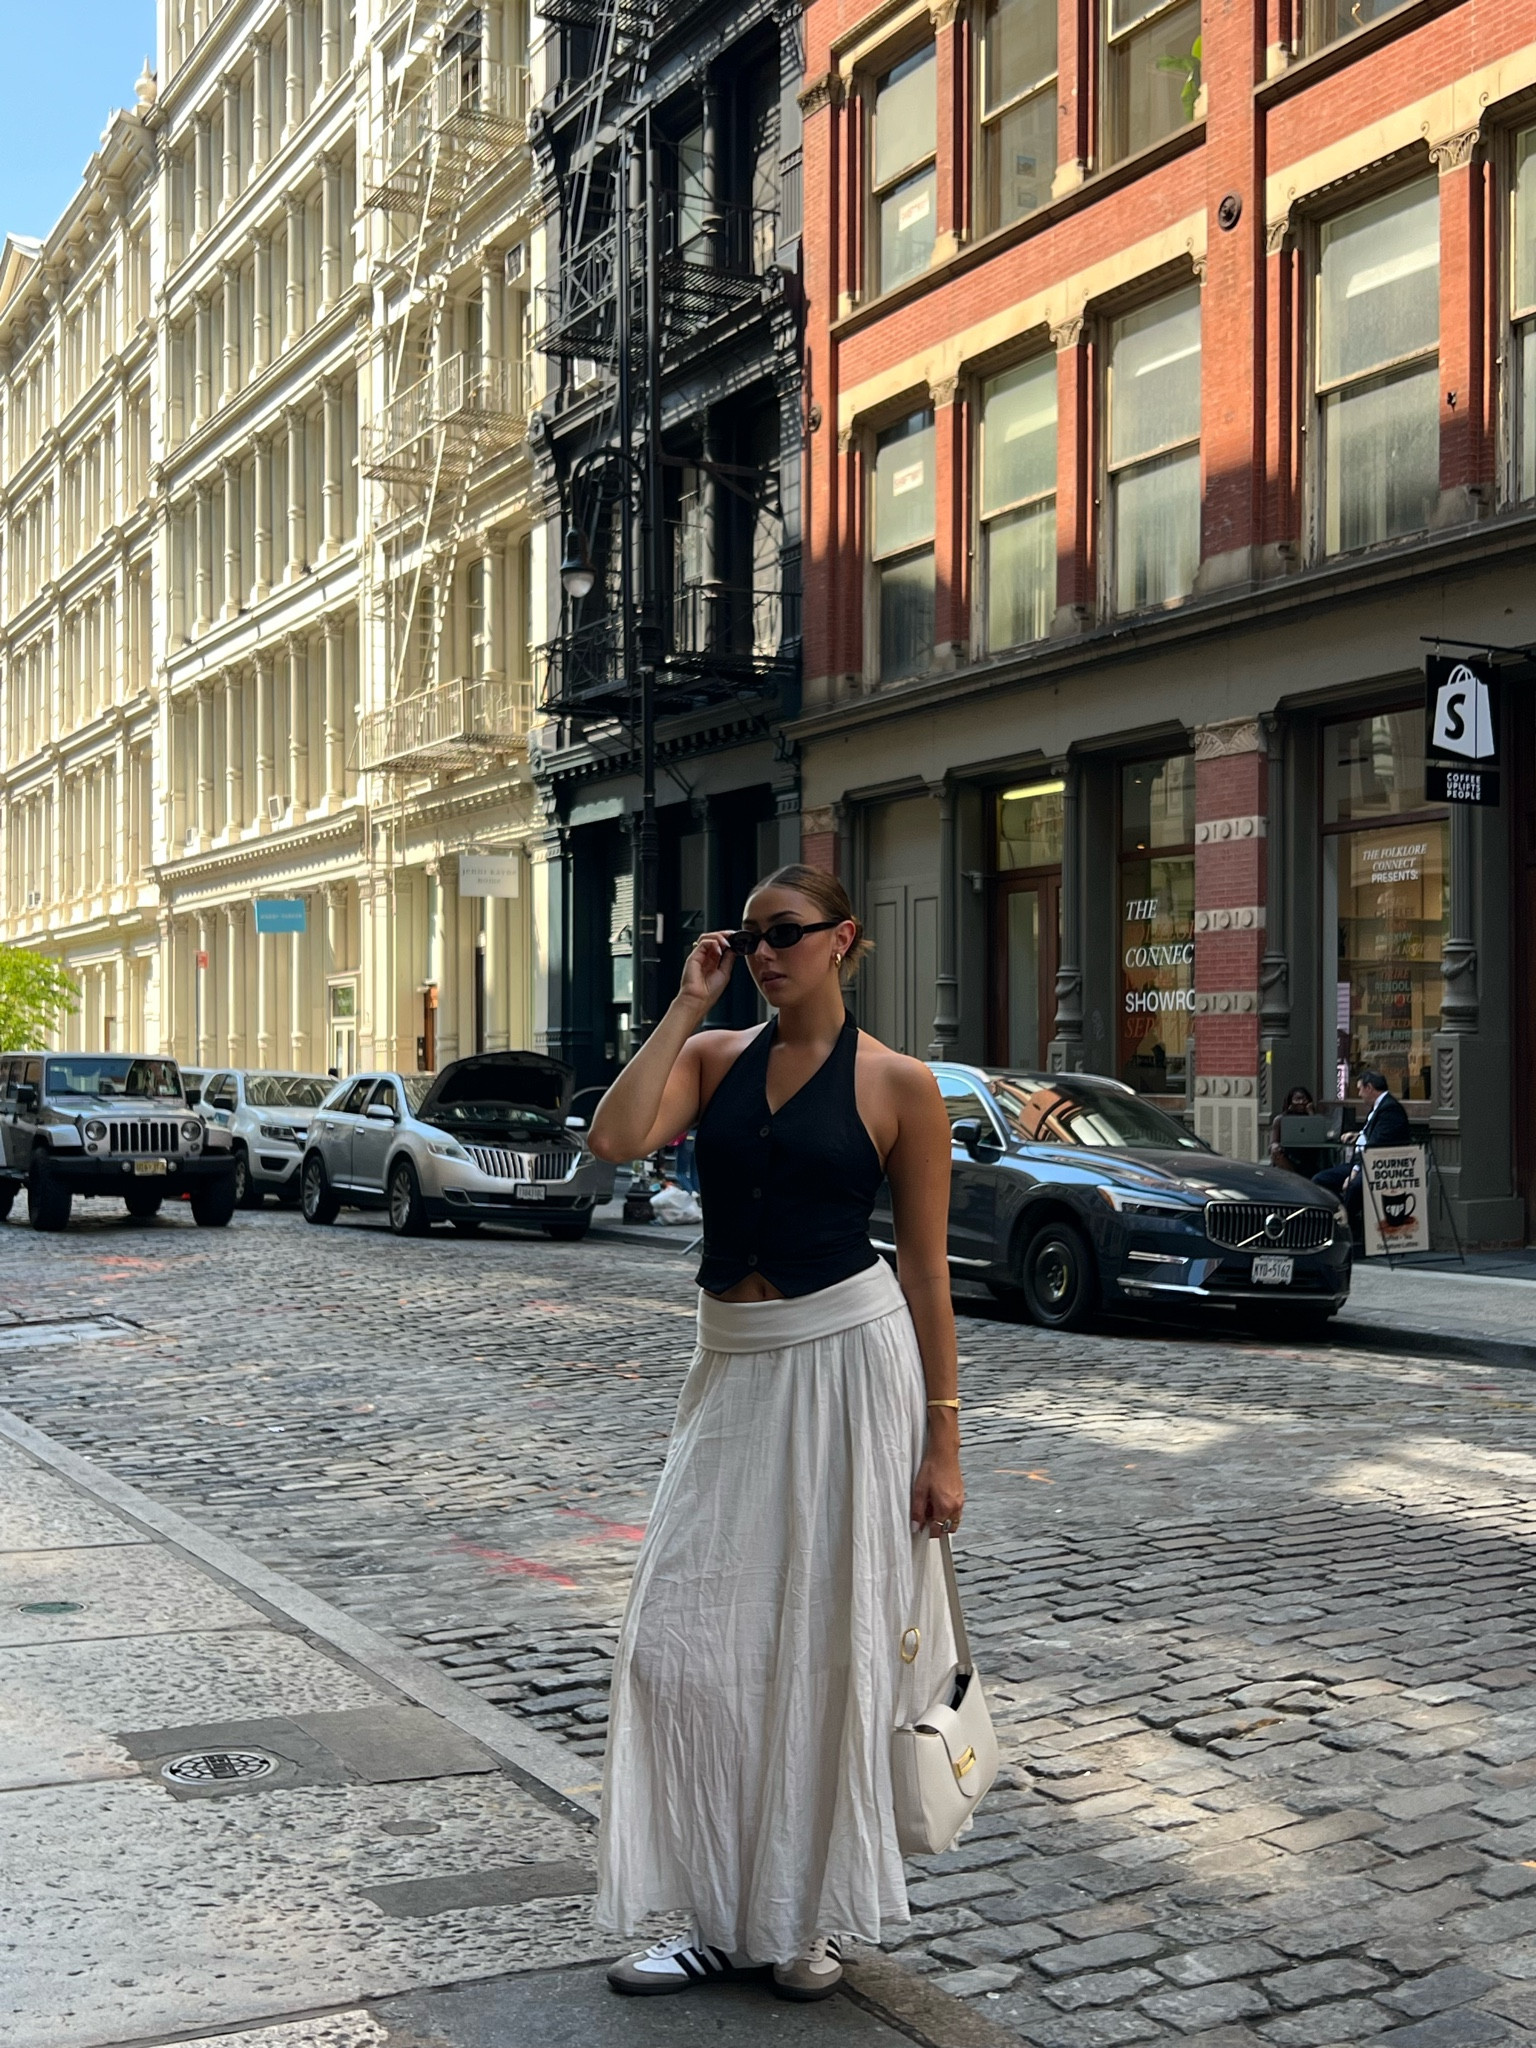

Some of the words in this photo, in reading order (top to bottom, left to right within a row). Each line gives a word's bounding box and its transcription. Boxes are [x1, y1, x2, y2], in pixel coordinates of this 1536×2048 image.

[1444, 693, 1466, 741] S
[1446, 772, 1481, 784] COFFEE
[1446, 782, 1481, 792] UPLIFTS
[1446, 790, 1481, 801] PEOPLE
[1363, 850, 1379, 861] THE
[1380, 843, 1428, 859] FOLKLORE
[1372, 858, 1417, 872] CONNECT
[1371, 869, 1419, 884] PRESENTS:
[1125, 899, 1158, 921] THE
[1125, 943, 1195, 968] CONNEC
[1371, 1158, 1417, 1170] JOURNEY
[1374, 1168, 1415, 1180] BOUNCE
[1369, 1181, 1390, 1191] TEA
[1390, 1178, 1420, 1190] LATTE
